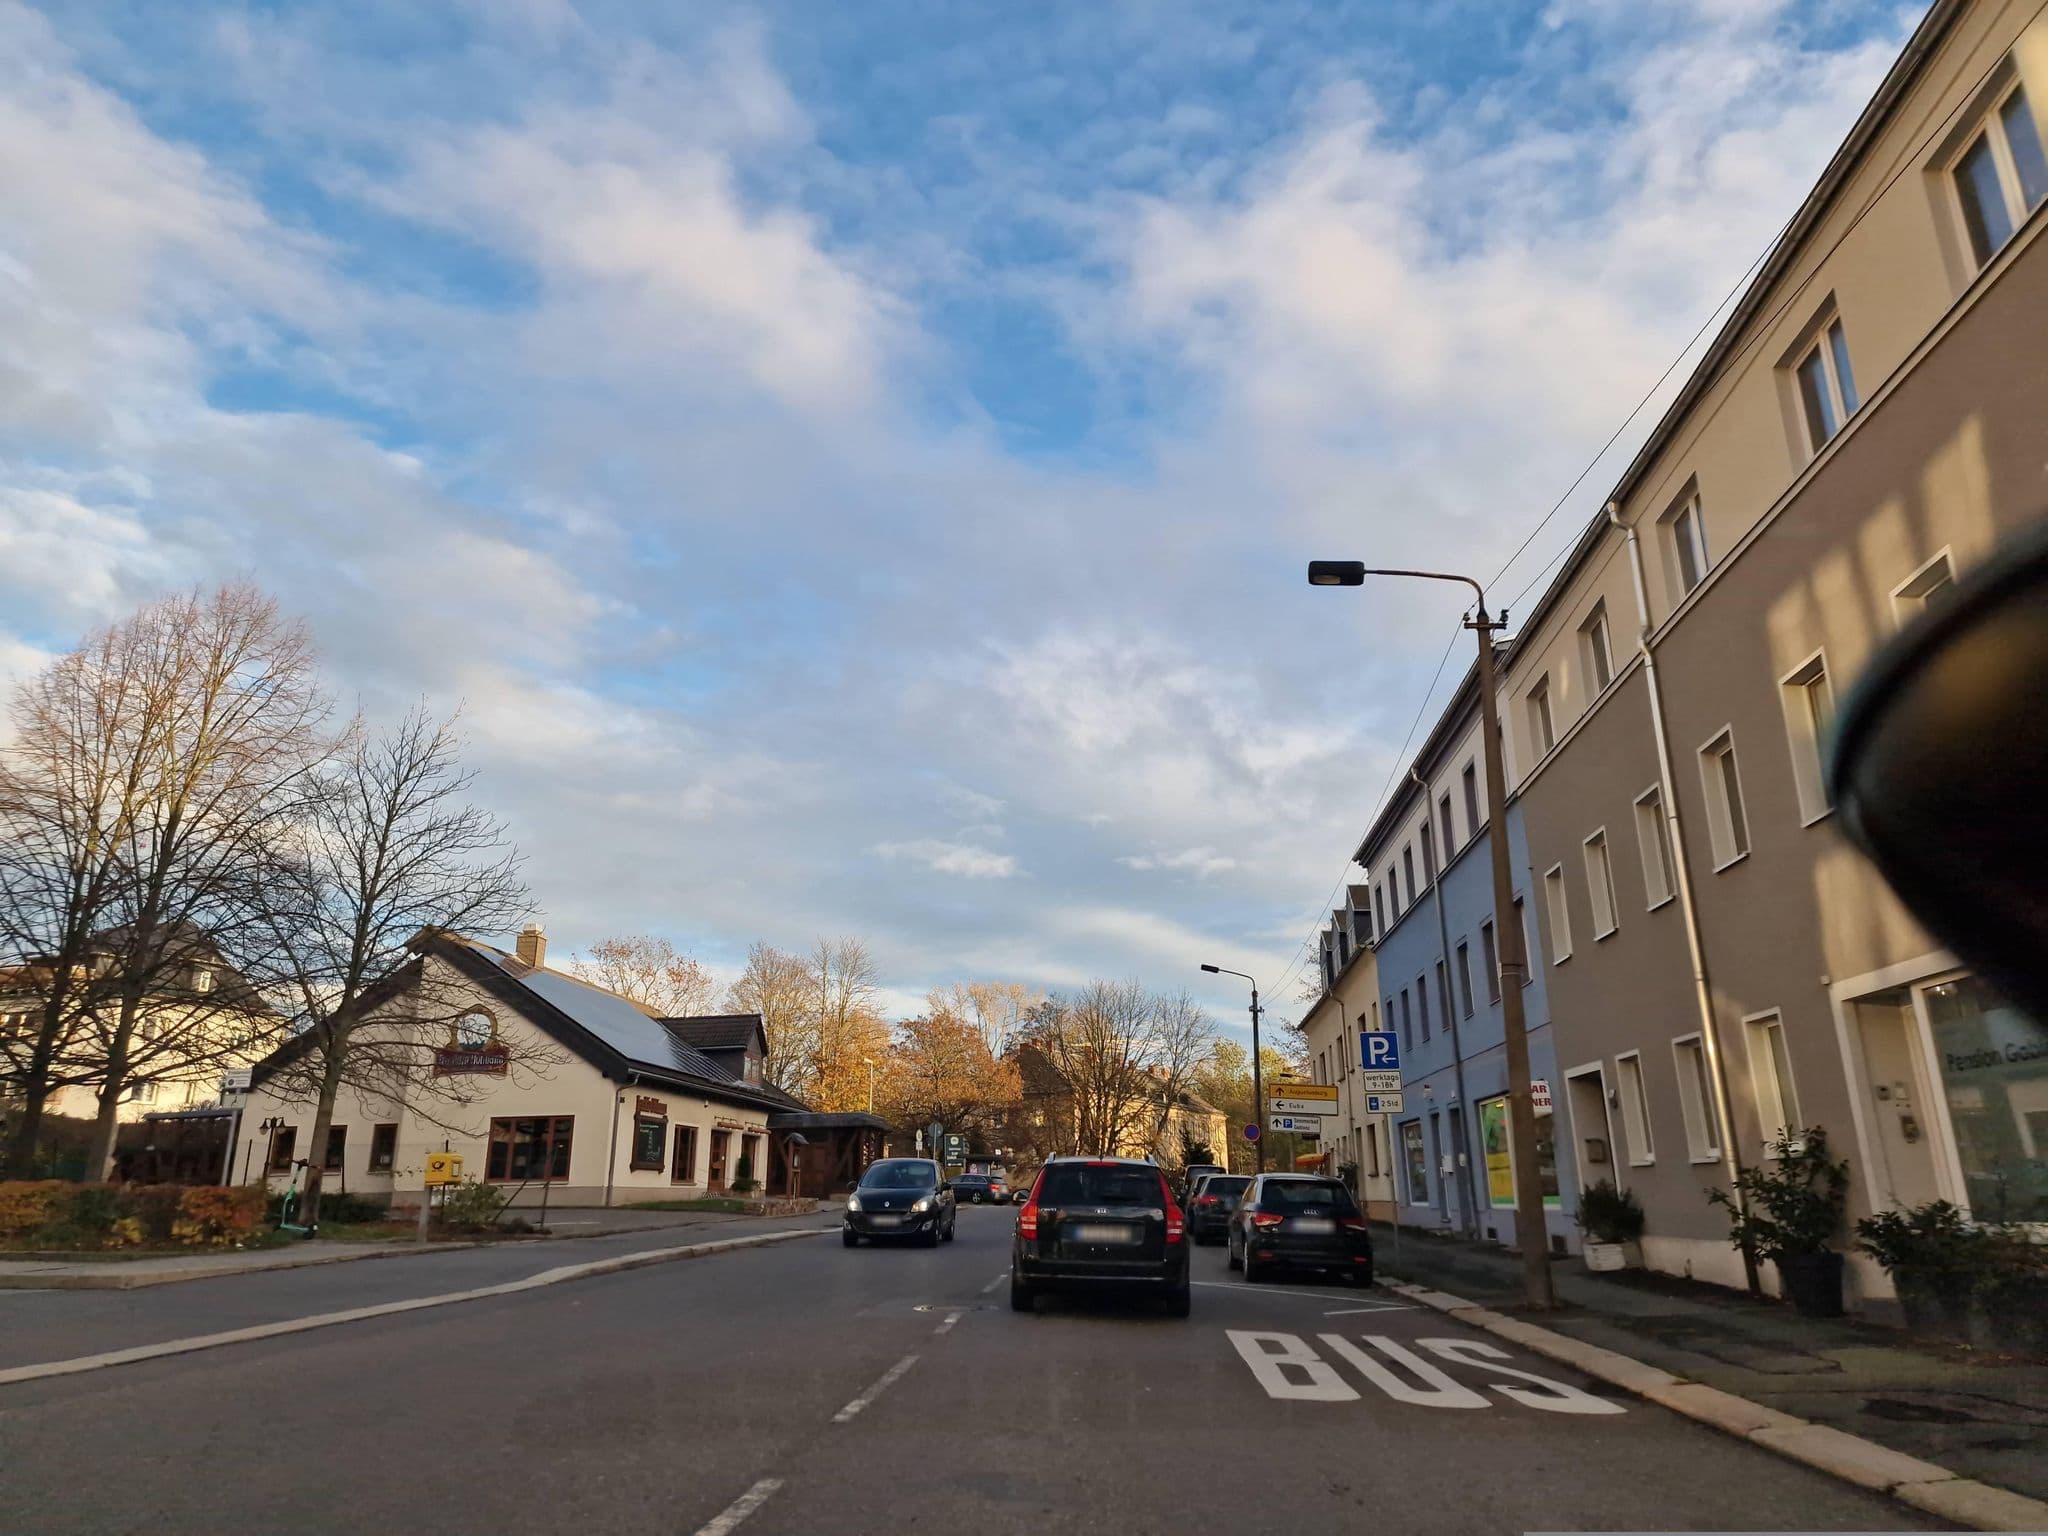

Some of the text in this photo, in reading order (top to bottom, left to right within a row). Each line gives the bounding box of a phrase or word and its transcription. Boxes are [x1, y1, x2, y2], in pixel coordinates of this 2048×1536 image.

[1368, 1036, 1390, 1066] P
[1366, 1074, 1400, 1083] werktags
[1225, 1329, 1628, 1415] BUS
